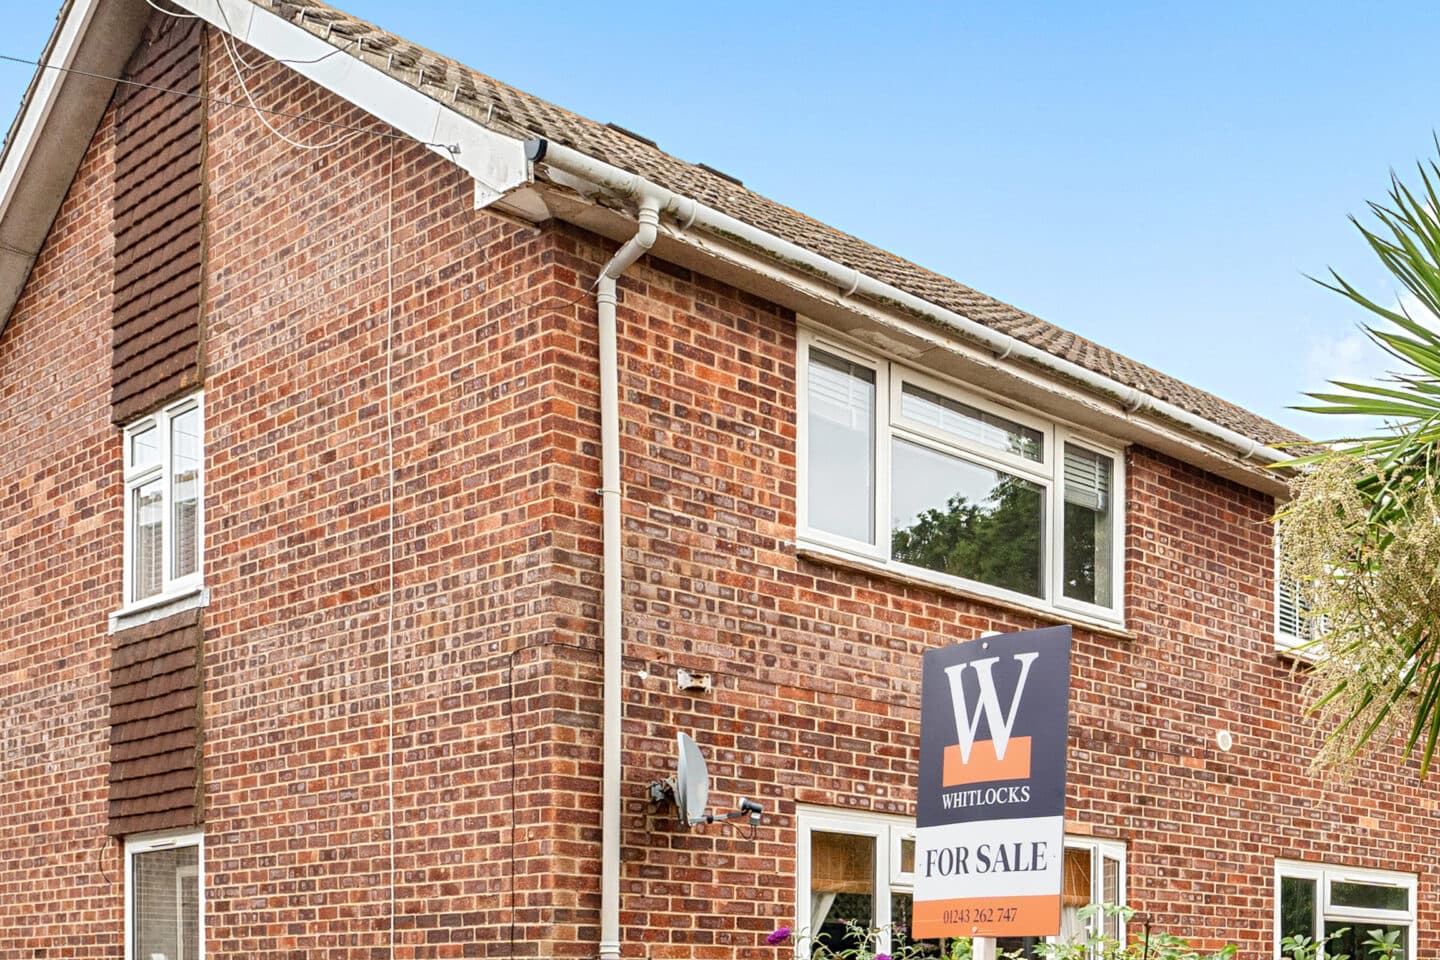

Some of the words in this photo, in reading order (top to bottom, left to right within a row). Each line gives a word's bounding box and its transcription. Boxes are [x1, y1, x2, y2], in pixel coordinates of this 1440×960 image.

[944, 652, 1039, 765] W
[942, 785, 1031, 810] WHITLOCKS
[925, 846, 970, 878] FOR
[976, 841, 1048, 874] SALE
[943, 909, 971, 924] 01243
[974, 907, 994, 923] 262
[997, 907, 1018, 922] 747
